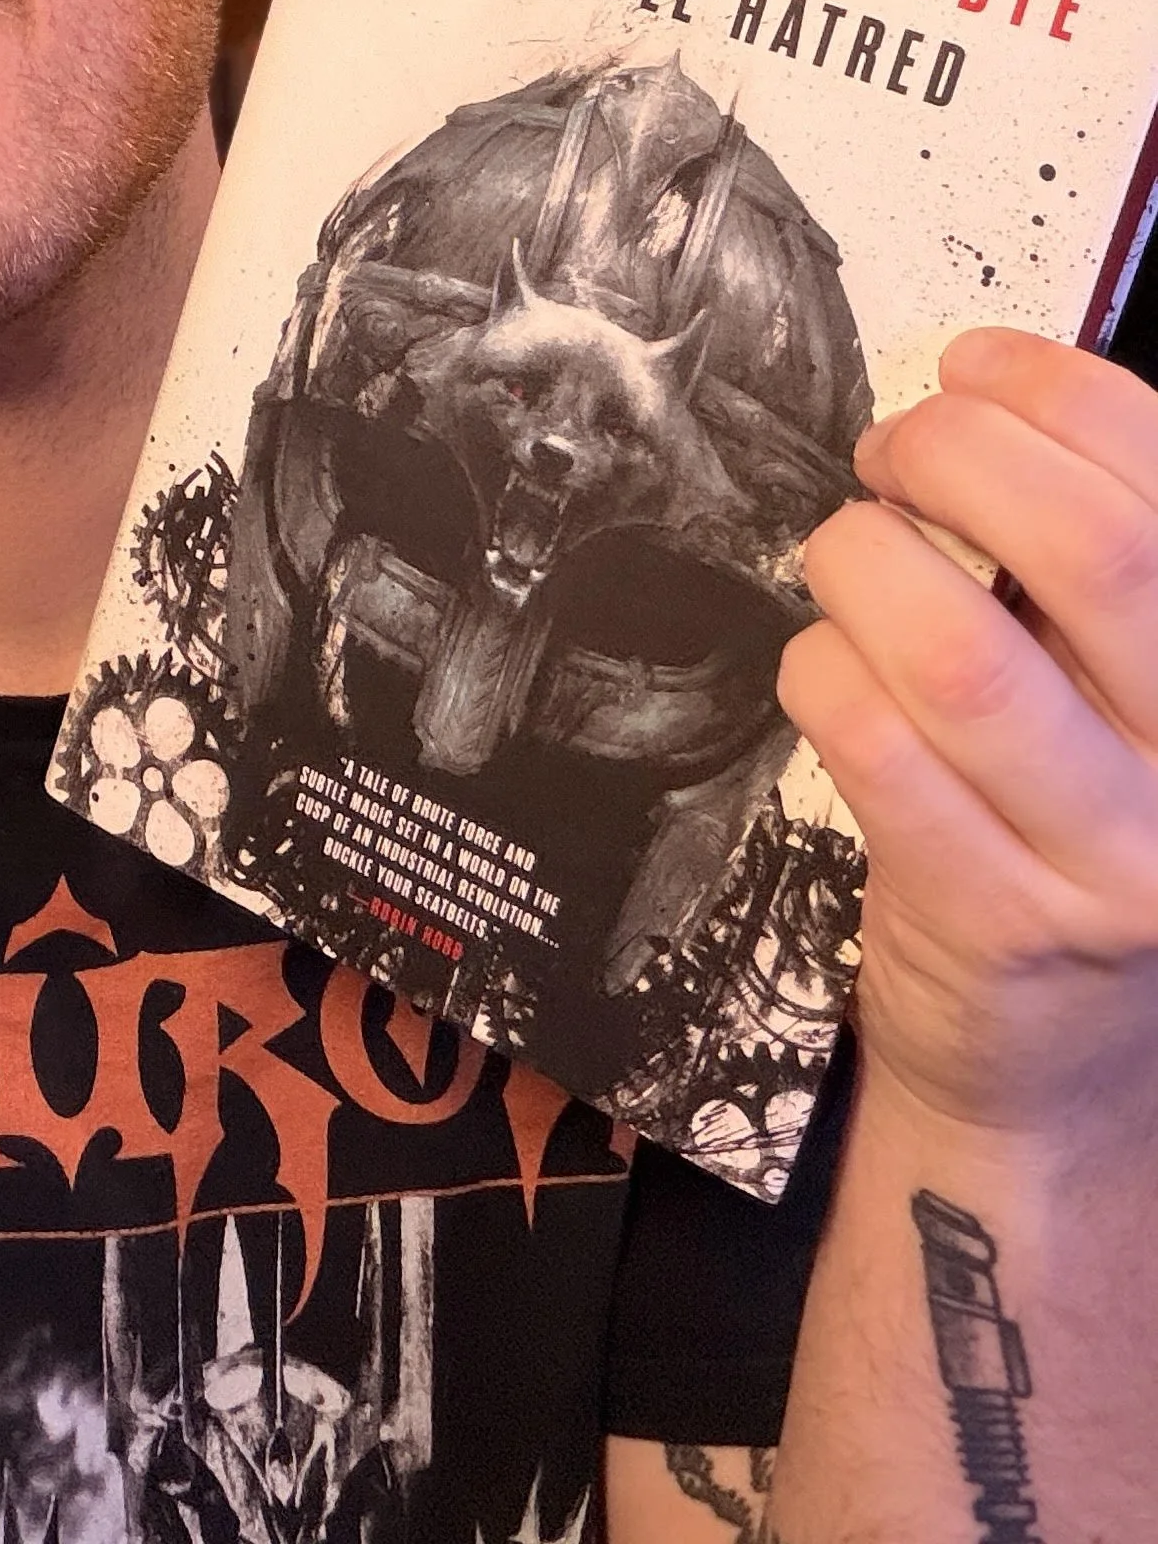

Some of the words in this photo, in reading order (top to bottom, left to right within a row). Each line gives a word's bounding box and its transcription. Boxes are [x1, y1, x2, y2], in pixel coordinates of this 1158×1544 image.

[295, 792, 331, 823] CUSP
[333, 812, 351, 834] OF
[351, 823, 373, 847] AN
[375, 835, 454, 892] INDUSTRIAL
[299, 765, 348, 805] SUBTLE
[349, 791, 393, 828] MAGIC
[395, 816, 422, 843] SET
[423, 830, 440, 854] IN
[442, 841, 453, 861] A
[458, 847, 506, 887] WORLD
[509, 876, 530, 901] ON
[533, 887, 561, 917] THE
[323, 836, 374, 877] BUCKLE
[377, 863, 413, 899] YOUR
[358, 765, 390, 796] TALE
[391, 783, 410, 806] OF
[411, 794, 456, 831] BRUTE
[458, 818, 502, 855] FORCE
[504, 842, 536, 872] AND
[422, 924, 464, 961] HOBB
